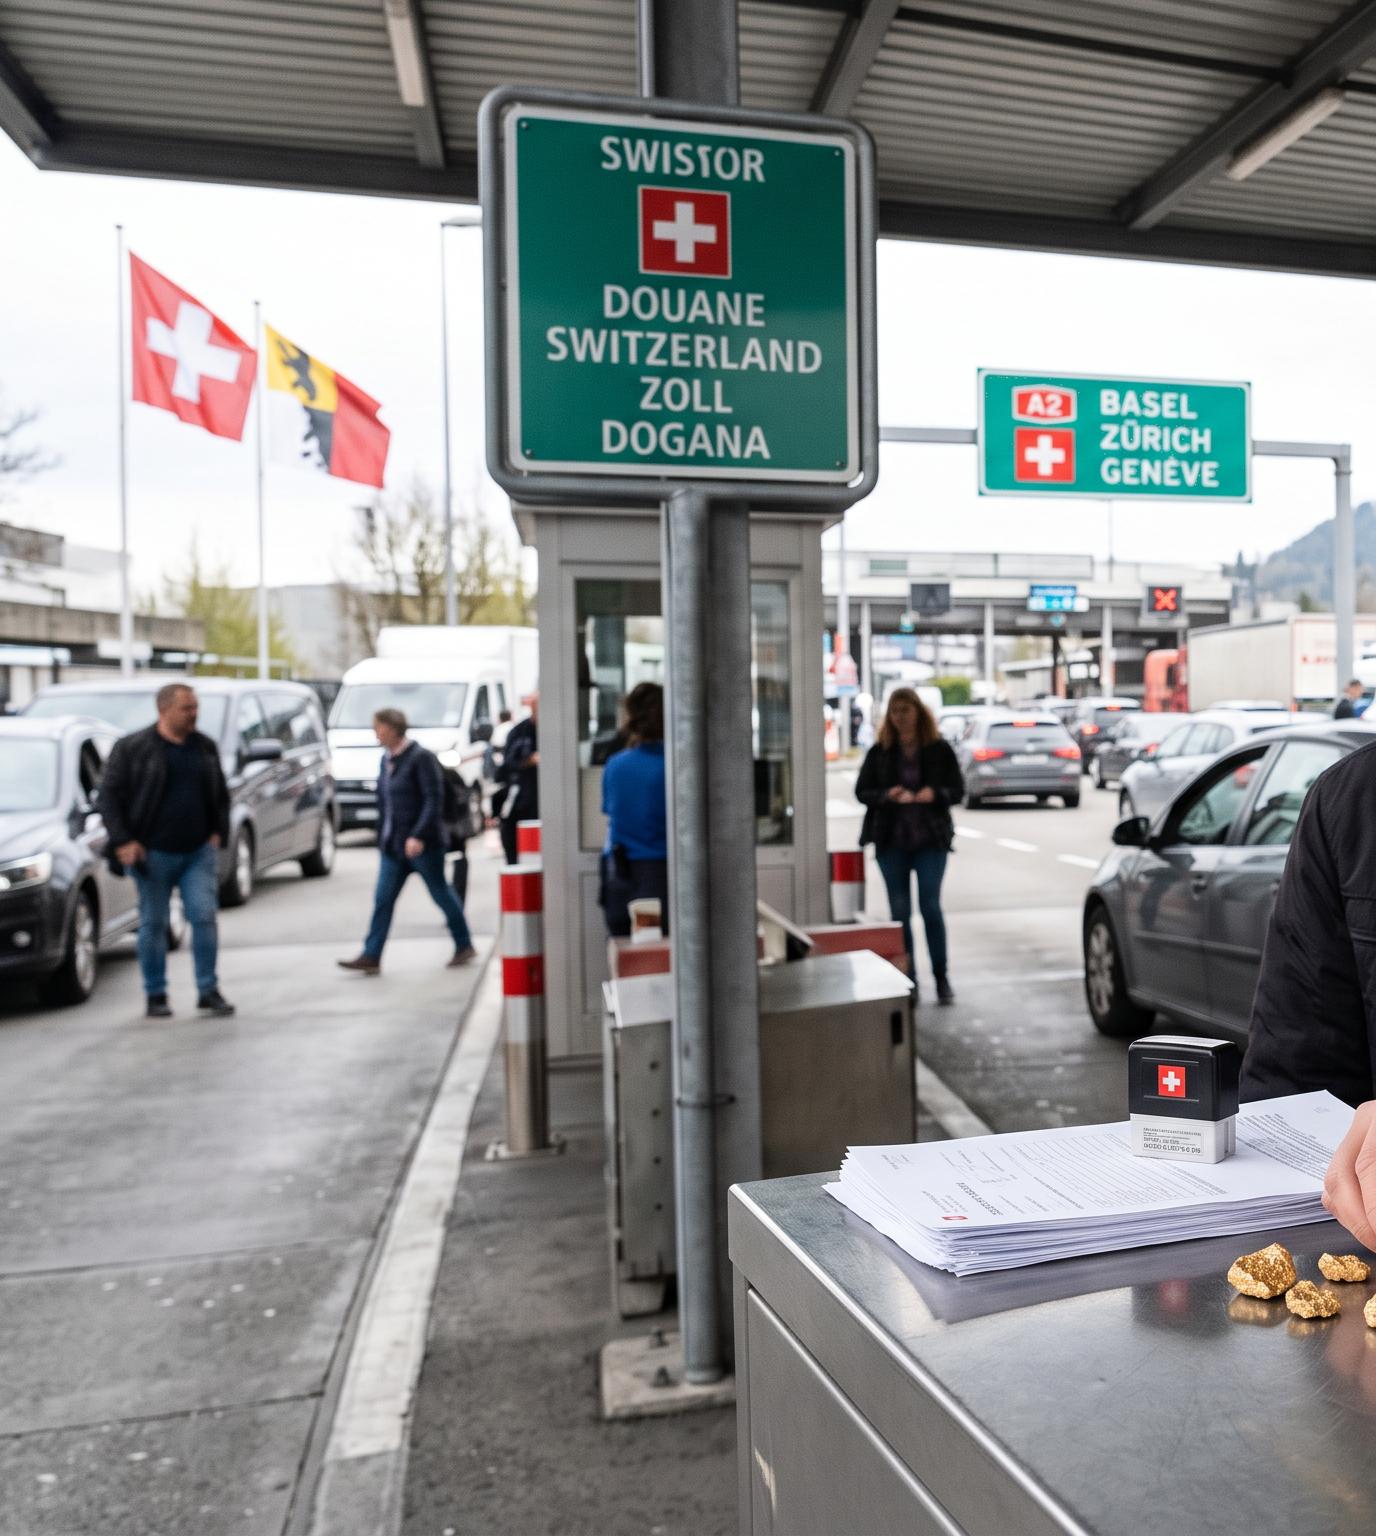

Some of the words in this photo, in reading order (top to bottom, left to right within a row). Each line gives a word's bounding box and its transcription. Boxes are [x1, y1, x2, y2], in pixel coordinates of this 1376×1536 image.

[603, 284, 766, 327] DOUANE
[546, 326, 822, 374] SWITZERLAND
[639, 376, 733, 414] ZOLL
[1026, 393, 1063, 417] A2
[1100, 389, 1197, 420] BASEL
[602, 420, 770, 459] DOGANA
[1100, 420, 1211, 453] ZÜRICH
